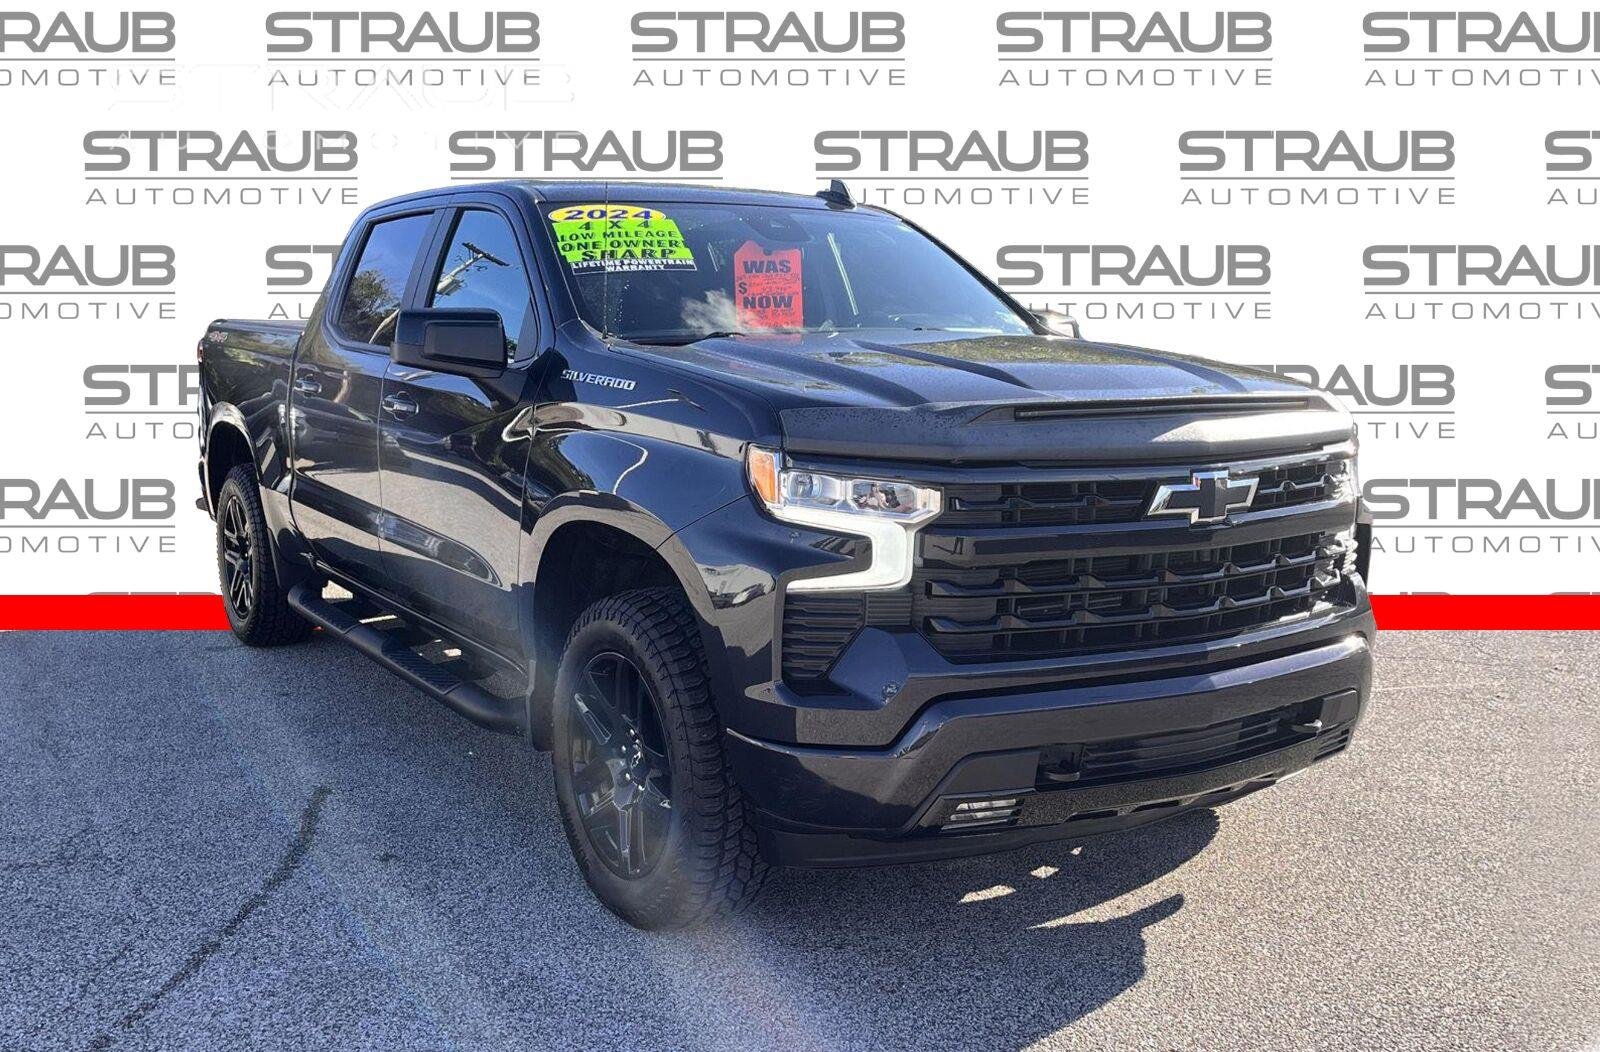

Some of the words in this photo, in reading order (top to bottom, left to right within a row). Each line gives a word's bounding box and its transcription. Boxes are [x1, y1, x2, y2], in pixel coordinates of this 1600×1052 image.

[564, 210, 652, 220] 2024
[578, 222, 592, 231] 4
[637, 220, 650, 228] 4
[560, 232, 594, 242] LOW
[603, 230, 676, 239] MILEAGE
[561, 241, 601, 252] ONE
[609, 240, 680, 249] OWNER
[582, 249, 676, 261] SHARP
[573, 260, 624, 269] LIFETIME
[743, 259, 791, 274] WAS
[738, 281, 748, 295] $
[743, 295, 793, 309] NOW
[560, 369, 636, 390] SILVERADO
